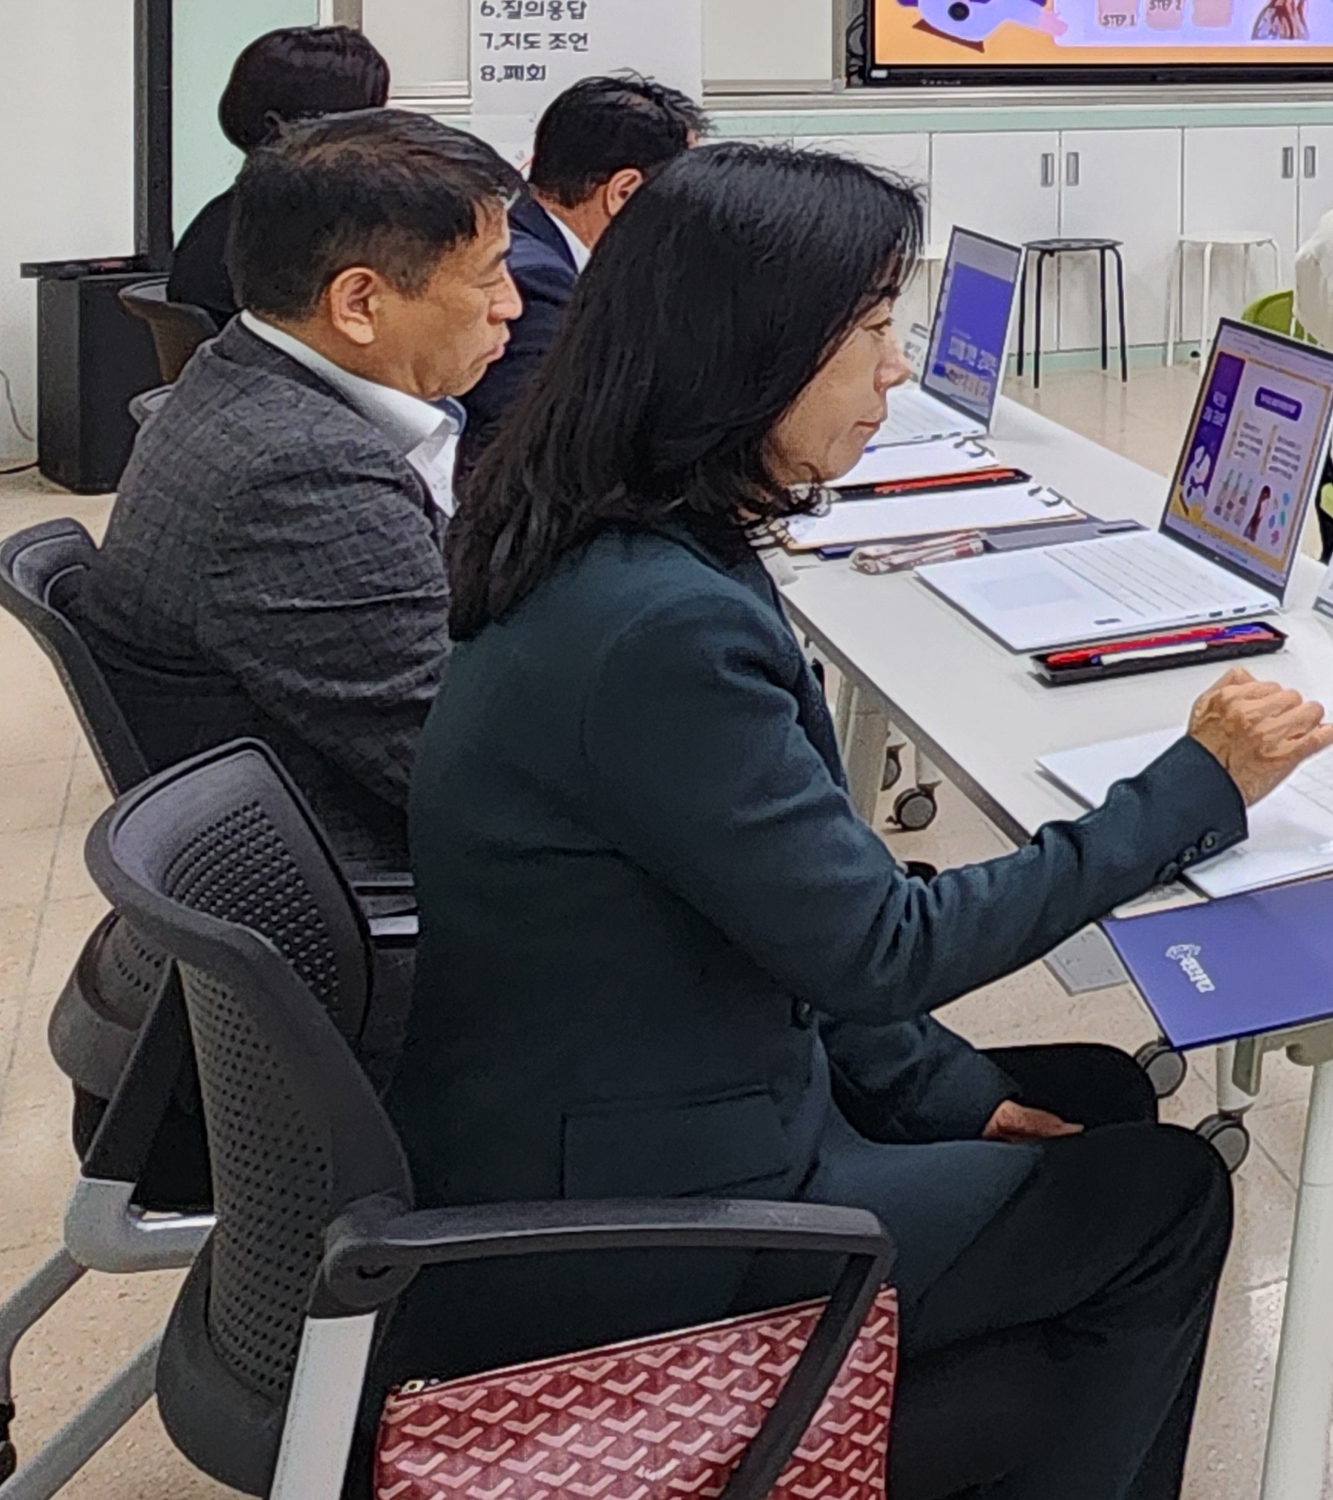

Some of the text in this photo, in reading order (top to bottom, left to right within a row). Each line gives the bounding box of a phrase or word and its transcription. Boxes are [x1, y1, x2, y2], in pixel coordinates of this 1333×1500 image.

[480, 0, 588, 21] 6.질의응답
[480, 32, 589, 53] 7.지도 조언
[480, 63, 547, 83] 8.폐회
